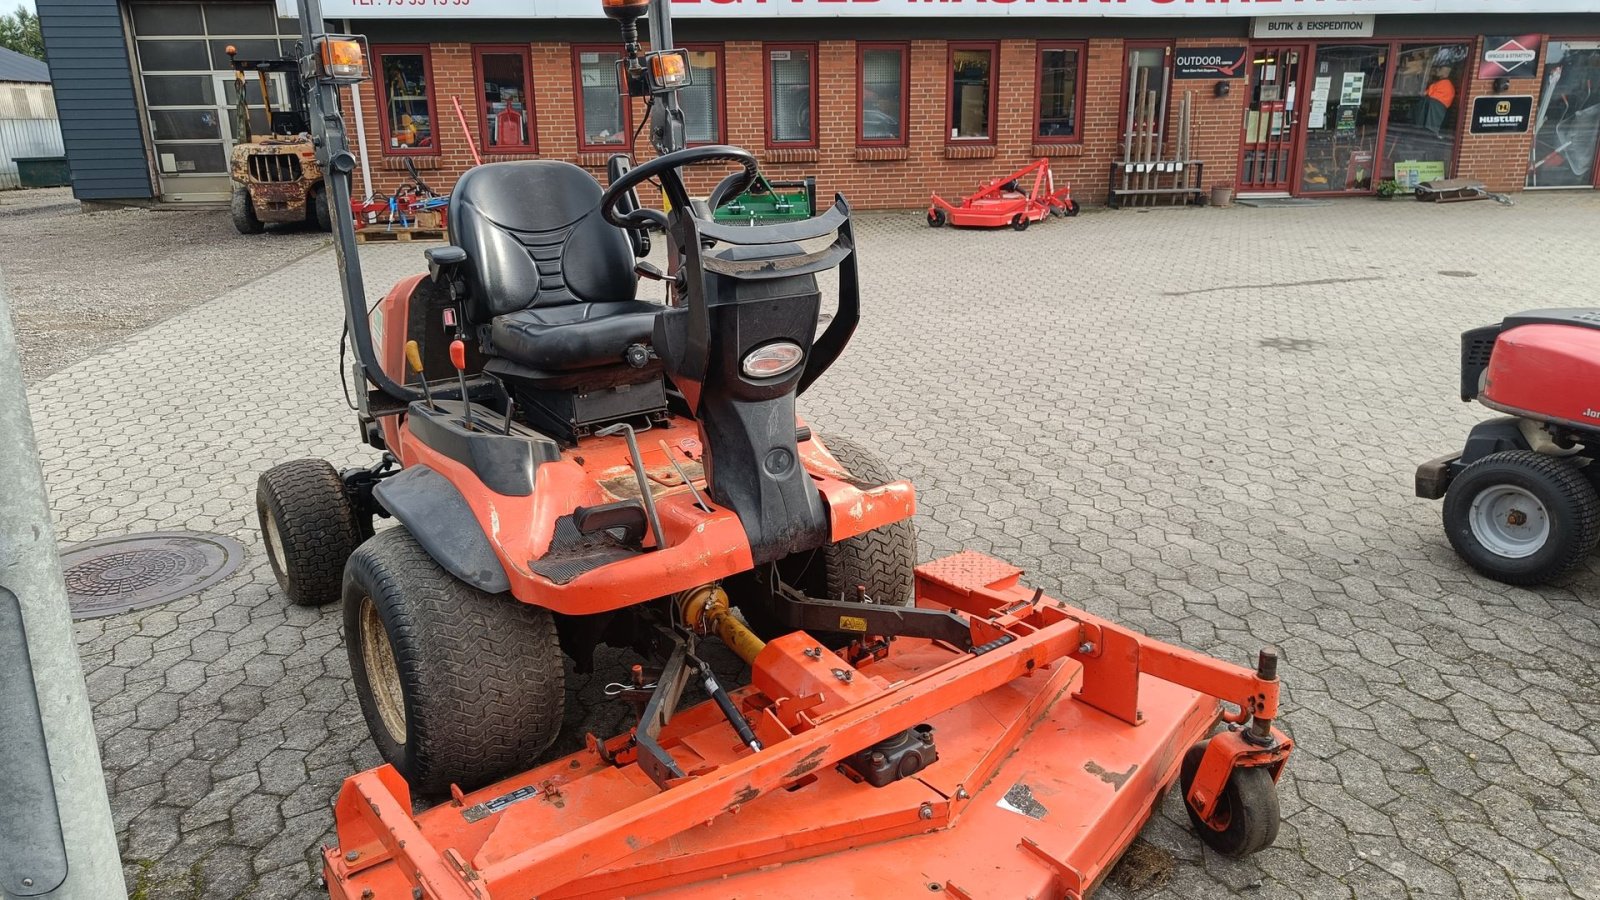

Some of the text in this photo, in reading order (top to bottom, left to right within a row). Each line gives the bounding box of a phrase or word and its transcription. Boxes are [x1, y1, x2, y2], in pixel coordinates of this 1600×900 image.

[1268, 21, 1363, 30] BUTIK & EKSPEDITION
[1177, 56, 1221, 65] OUTDOOR
